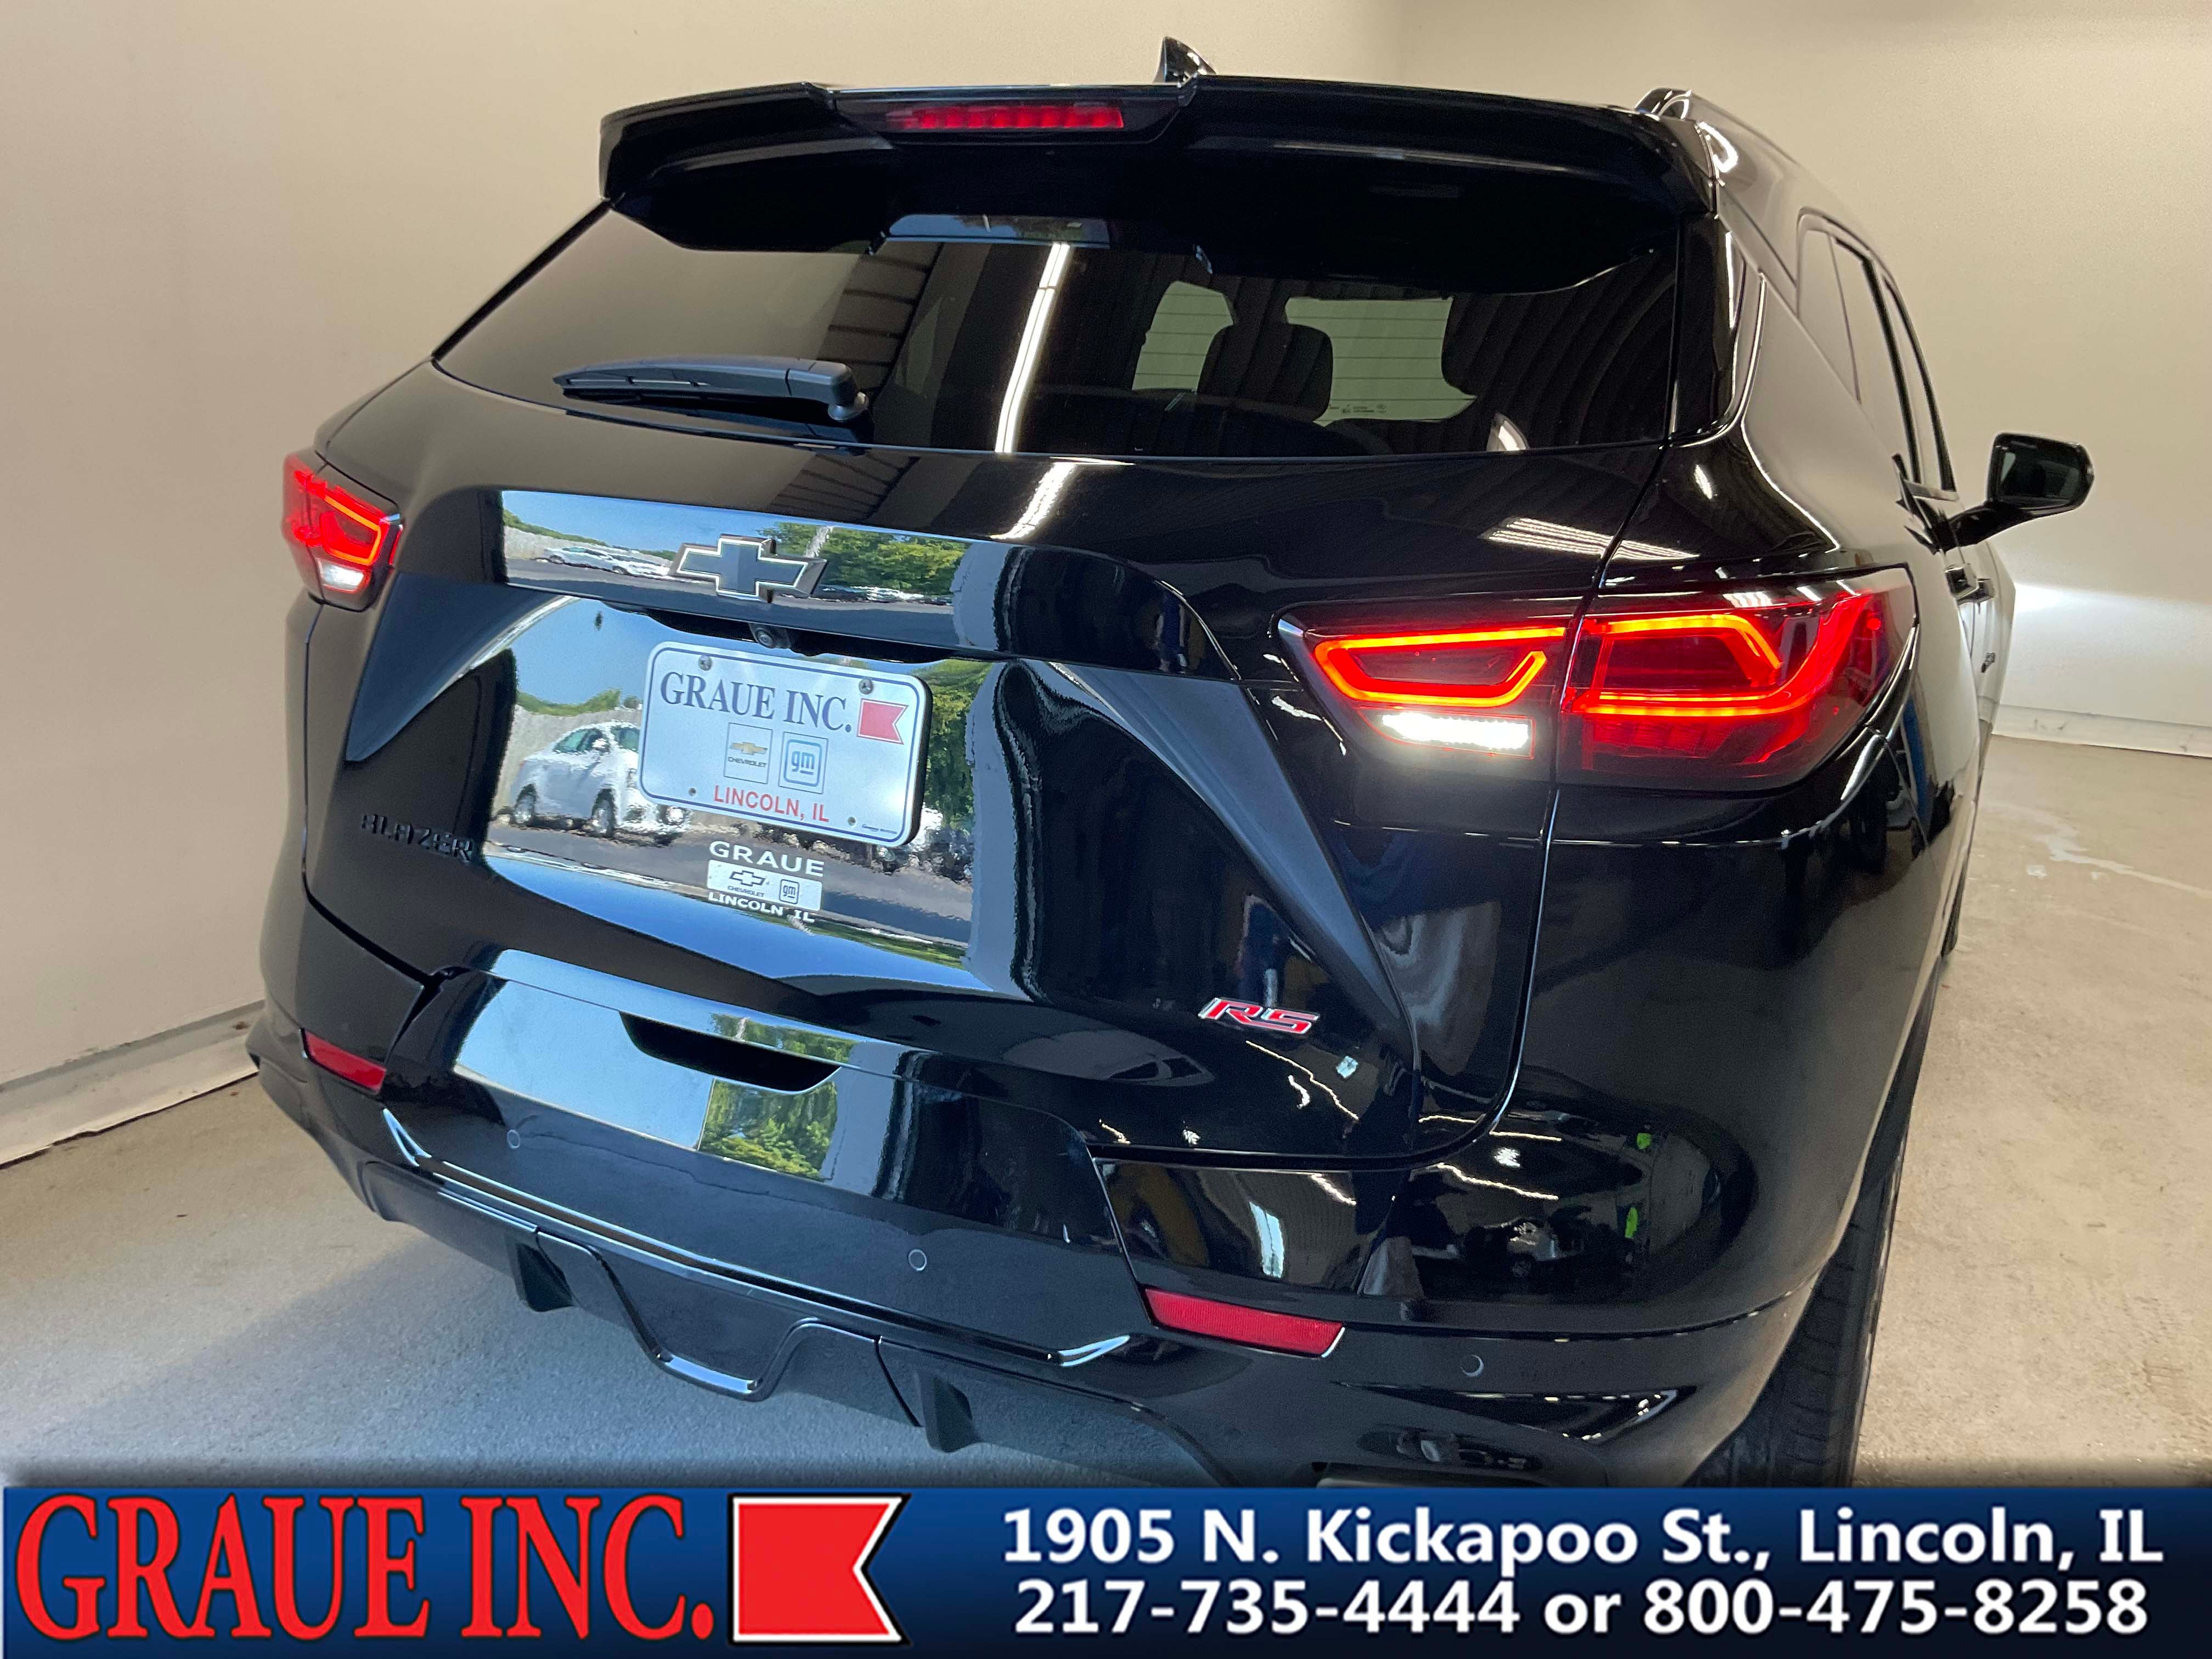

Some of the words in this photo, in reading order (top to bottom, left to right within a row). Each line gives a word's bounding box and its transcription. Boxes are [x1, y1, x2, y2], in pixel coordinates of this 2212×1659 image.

[661, 672, 776, 720] GRAUE
[783, 690, 852, 733] INC.
[727, 756, 767, 769] CHEVROLET
[714, 785, 805, 821] LINCOLN,
[812, 803, 830, 822] IL
[709, 840, 825, 877] GRAUE
[708, 891, 784, 916] LINCOLN
[794, 909, 815, 923] IL
[727, 885, 765, 898] CHEVROLET
[1198, 997, 1321, 1035] RS
